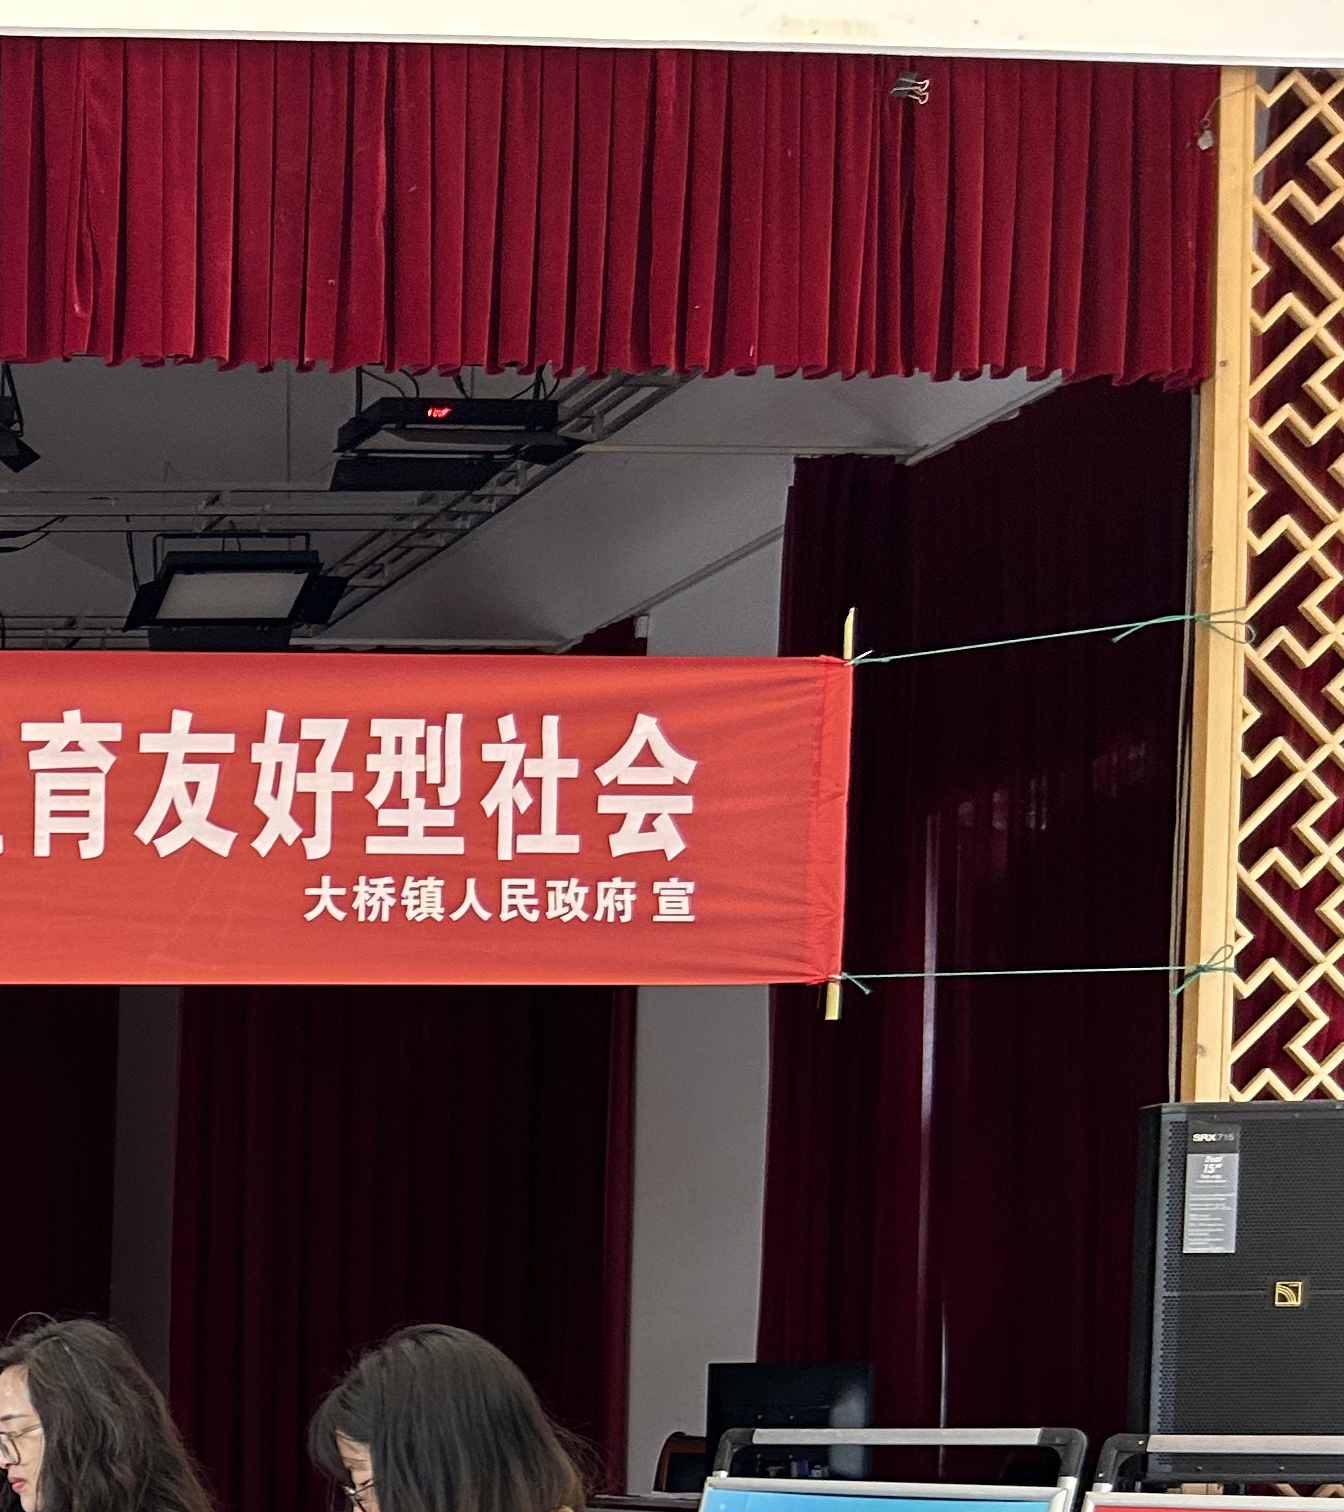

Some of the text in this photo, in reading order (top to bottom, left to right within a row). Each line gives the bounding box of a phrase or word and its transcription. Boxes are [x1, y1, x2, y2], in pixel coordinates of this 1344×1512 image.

[304, 875, 696, 923] 大桥镇人民政府 宣
